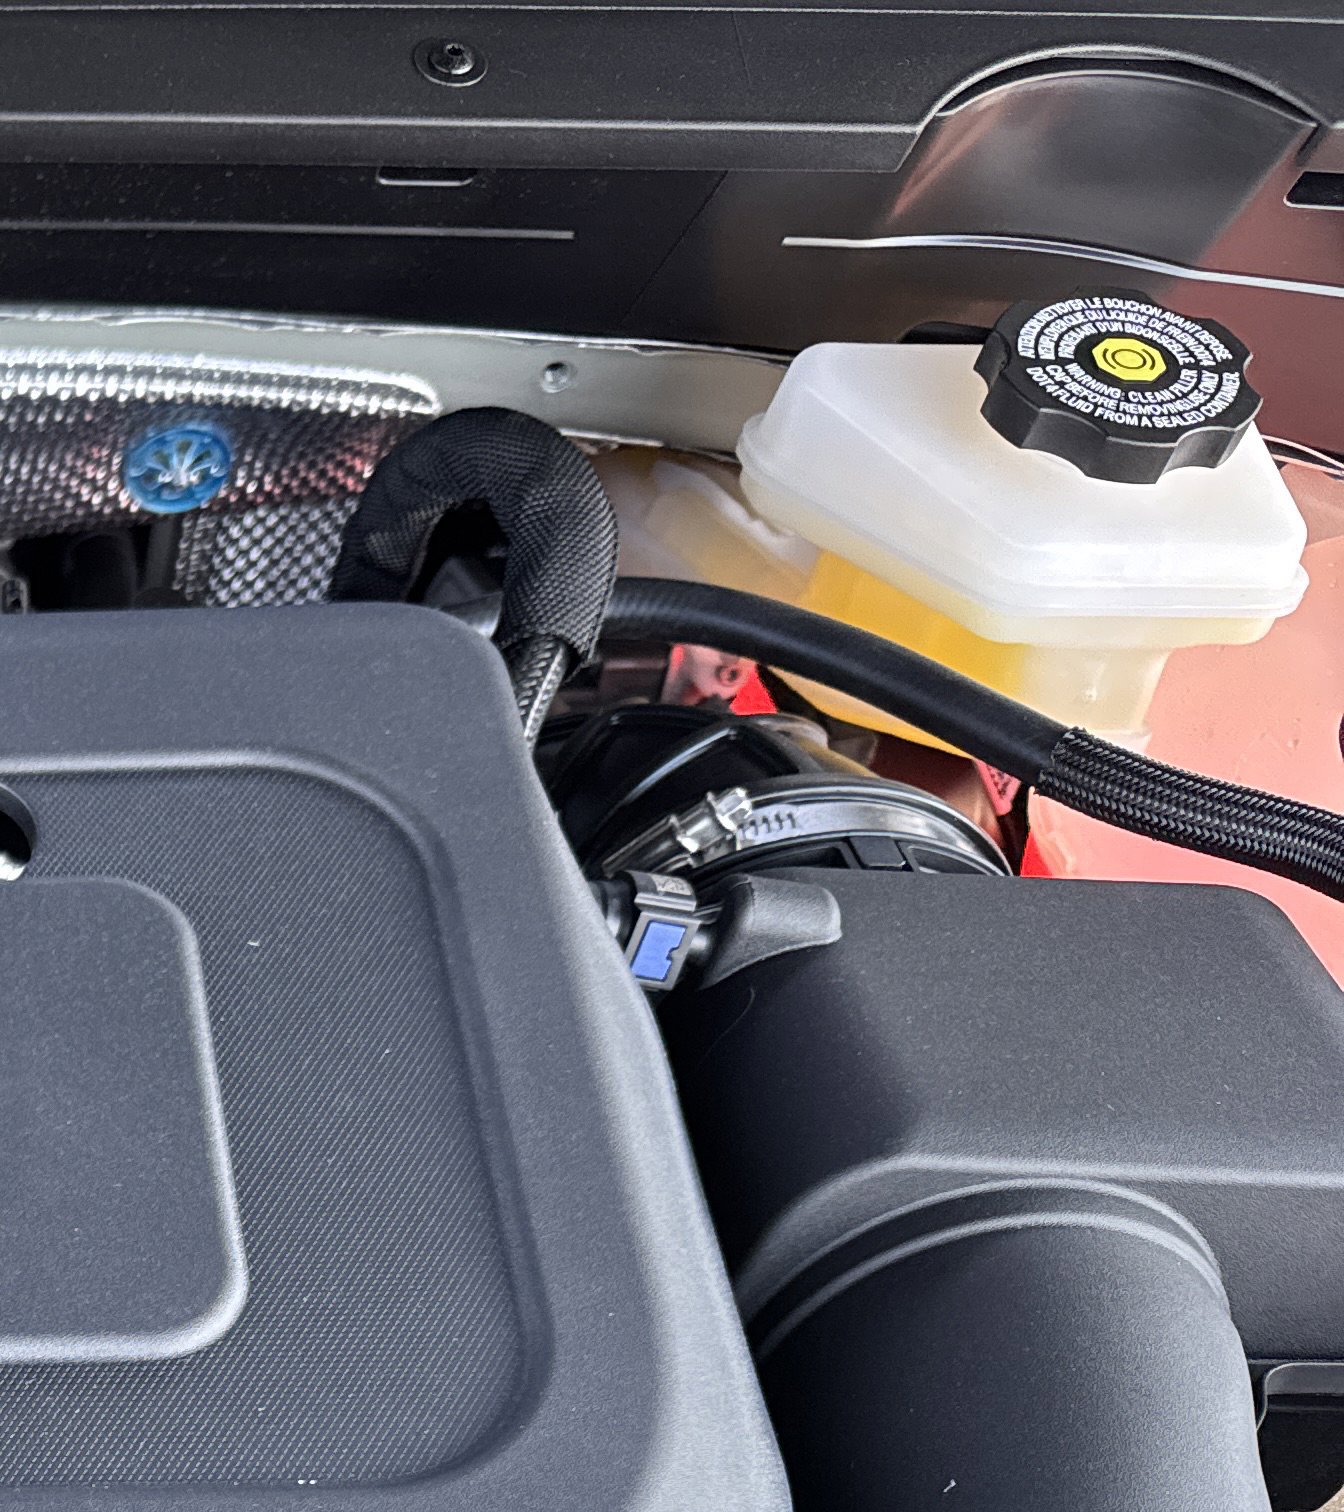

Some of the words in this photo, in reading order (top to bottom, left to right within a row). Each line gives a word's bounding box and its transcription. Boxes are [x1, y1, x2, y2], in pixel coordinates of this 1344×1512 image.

[1085, 309, 1103, 322] DU
[1102, 310, 1150, 326] LIQUIDE
[1149, 318, 1168, 332] DE
[1086, 297, 1103, 309] LE
[1103, 297, 1162, 318] BOUCHON
[1162, 312, 1202, 334] AVANT
[1125, 322, 1161, 341] BIDON
[1046, 364, 1074, 384] CAP
[1065, 382, 1118, 409] BEFORE
[1183, 389, 1211, 408] USE
[1198, 370, 1220, 394] ONLY
[1128, 388, 1176, 404] CLEAN
[1169, 368, 1198, 398] FILLER
[1052, 389, 1095, 414] FLUID
[1094, 407, 1139, 427] FROM
[1141, 416, 1153, 428] A
[1152, 411, 1206, 429] SEALED
